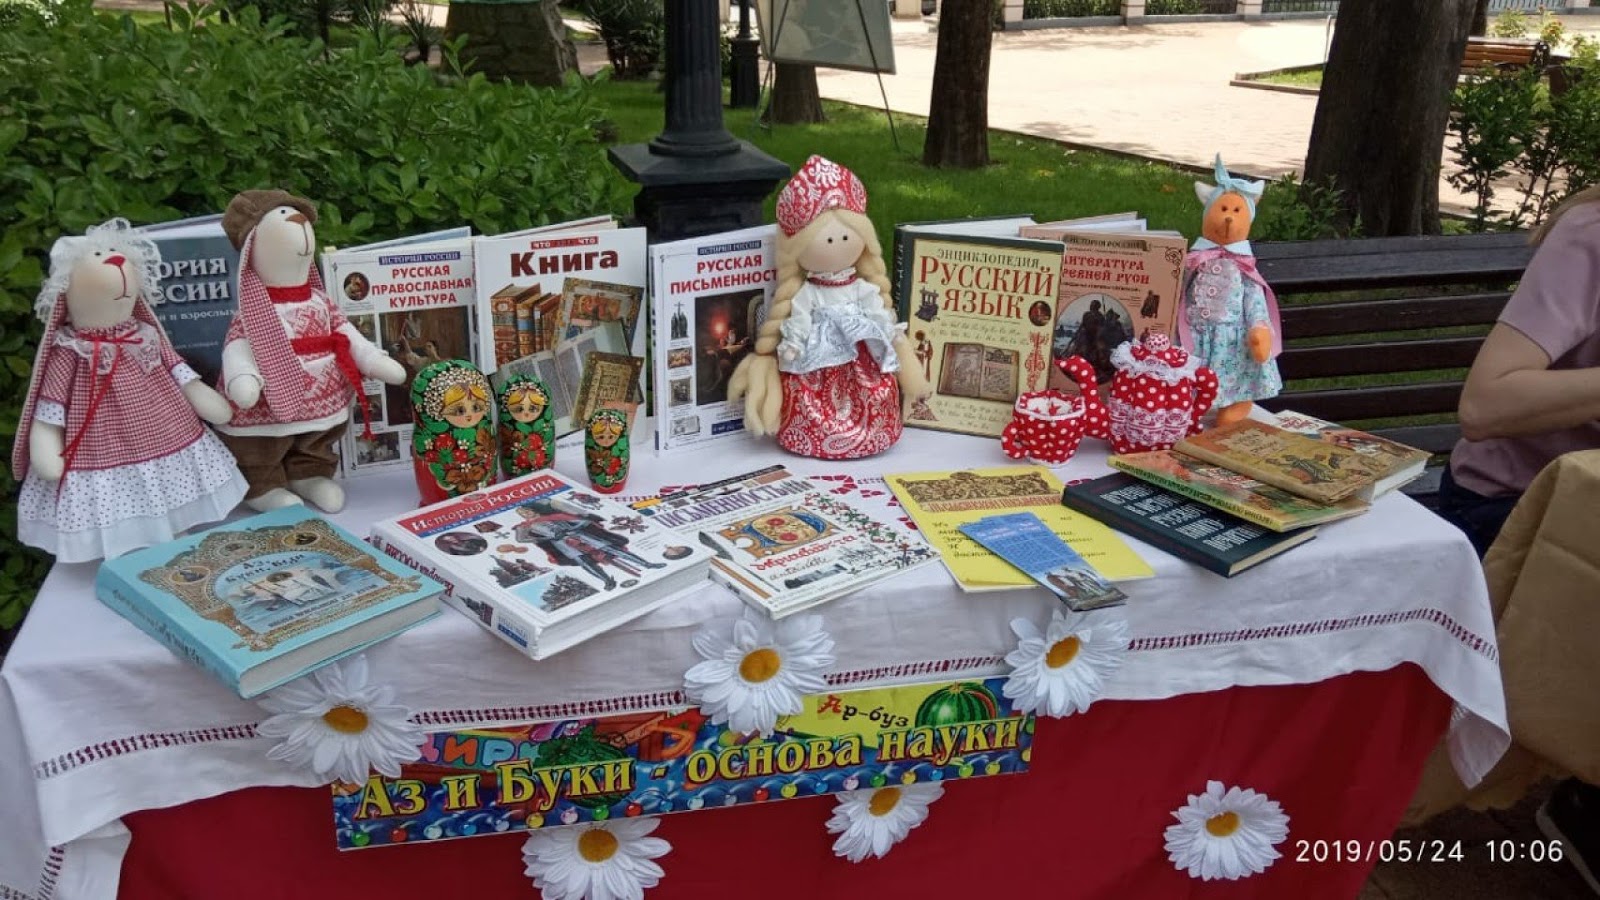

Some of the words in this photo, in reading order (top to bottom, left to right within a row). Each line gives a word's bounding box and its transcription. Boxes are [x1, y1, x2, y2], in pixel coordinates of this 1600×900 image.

[160, 257, 228, 279] ОРИЯ
[510, 250, 618, 278] Книга
[697, 254, 762, 274] РУССКАЯ
[937, 248, 1041, 269] ЭНЦИКЛОПЕДИЯ
[392, 264, 451, 279] РУССКАЯ
[670, 269, 777, 295] ПИСЬМЕННОСТ
[371, 277, 473, 295] ПРАВОСЛАВНАЯ
[389, 292, 457, 309] КУЛЬТУРА
[941, 288, 1025, 320] ЯЗЫК
[411, 502, 486, 532] История
[486, 478, 556, 507] РОССИИ
[817, 694, 909, 729] Ар-буз
[355, 774, 429, 821] Аз
[443, 776, 484, 812] и
[498, 759, 636, 812] Буки
[686, 734, 863, 785] основа
[878, 717, 1027, 767] науки
